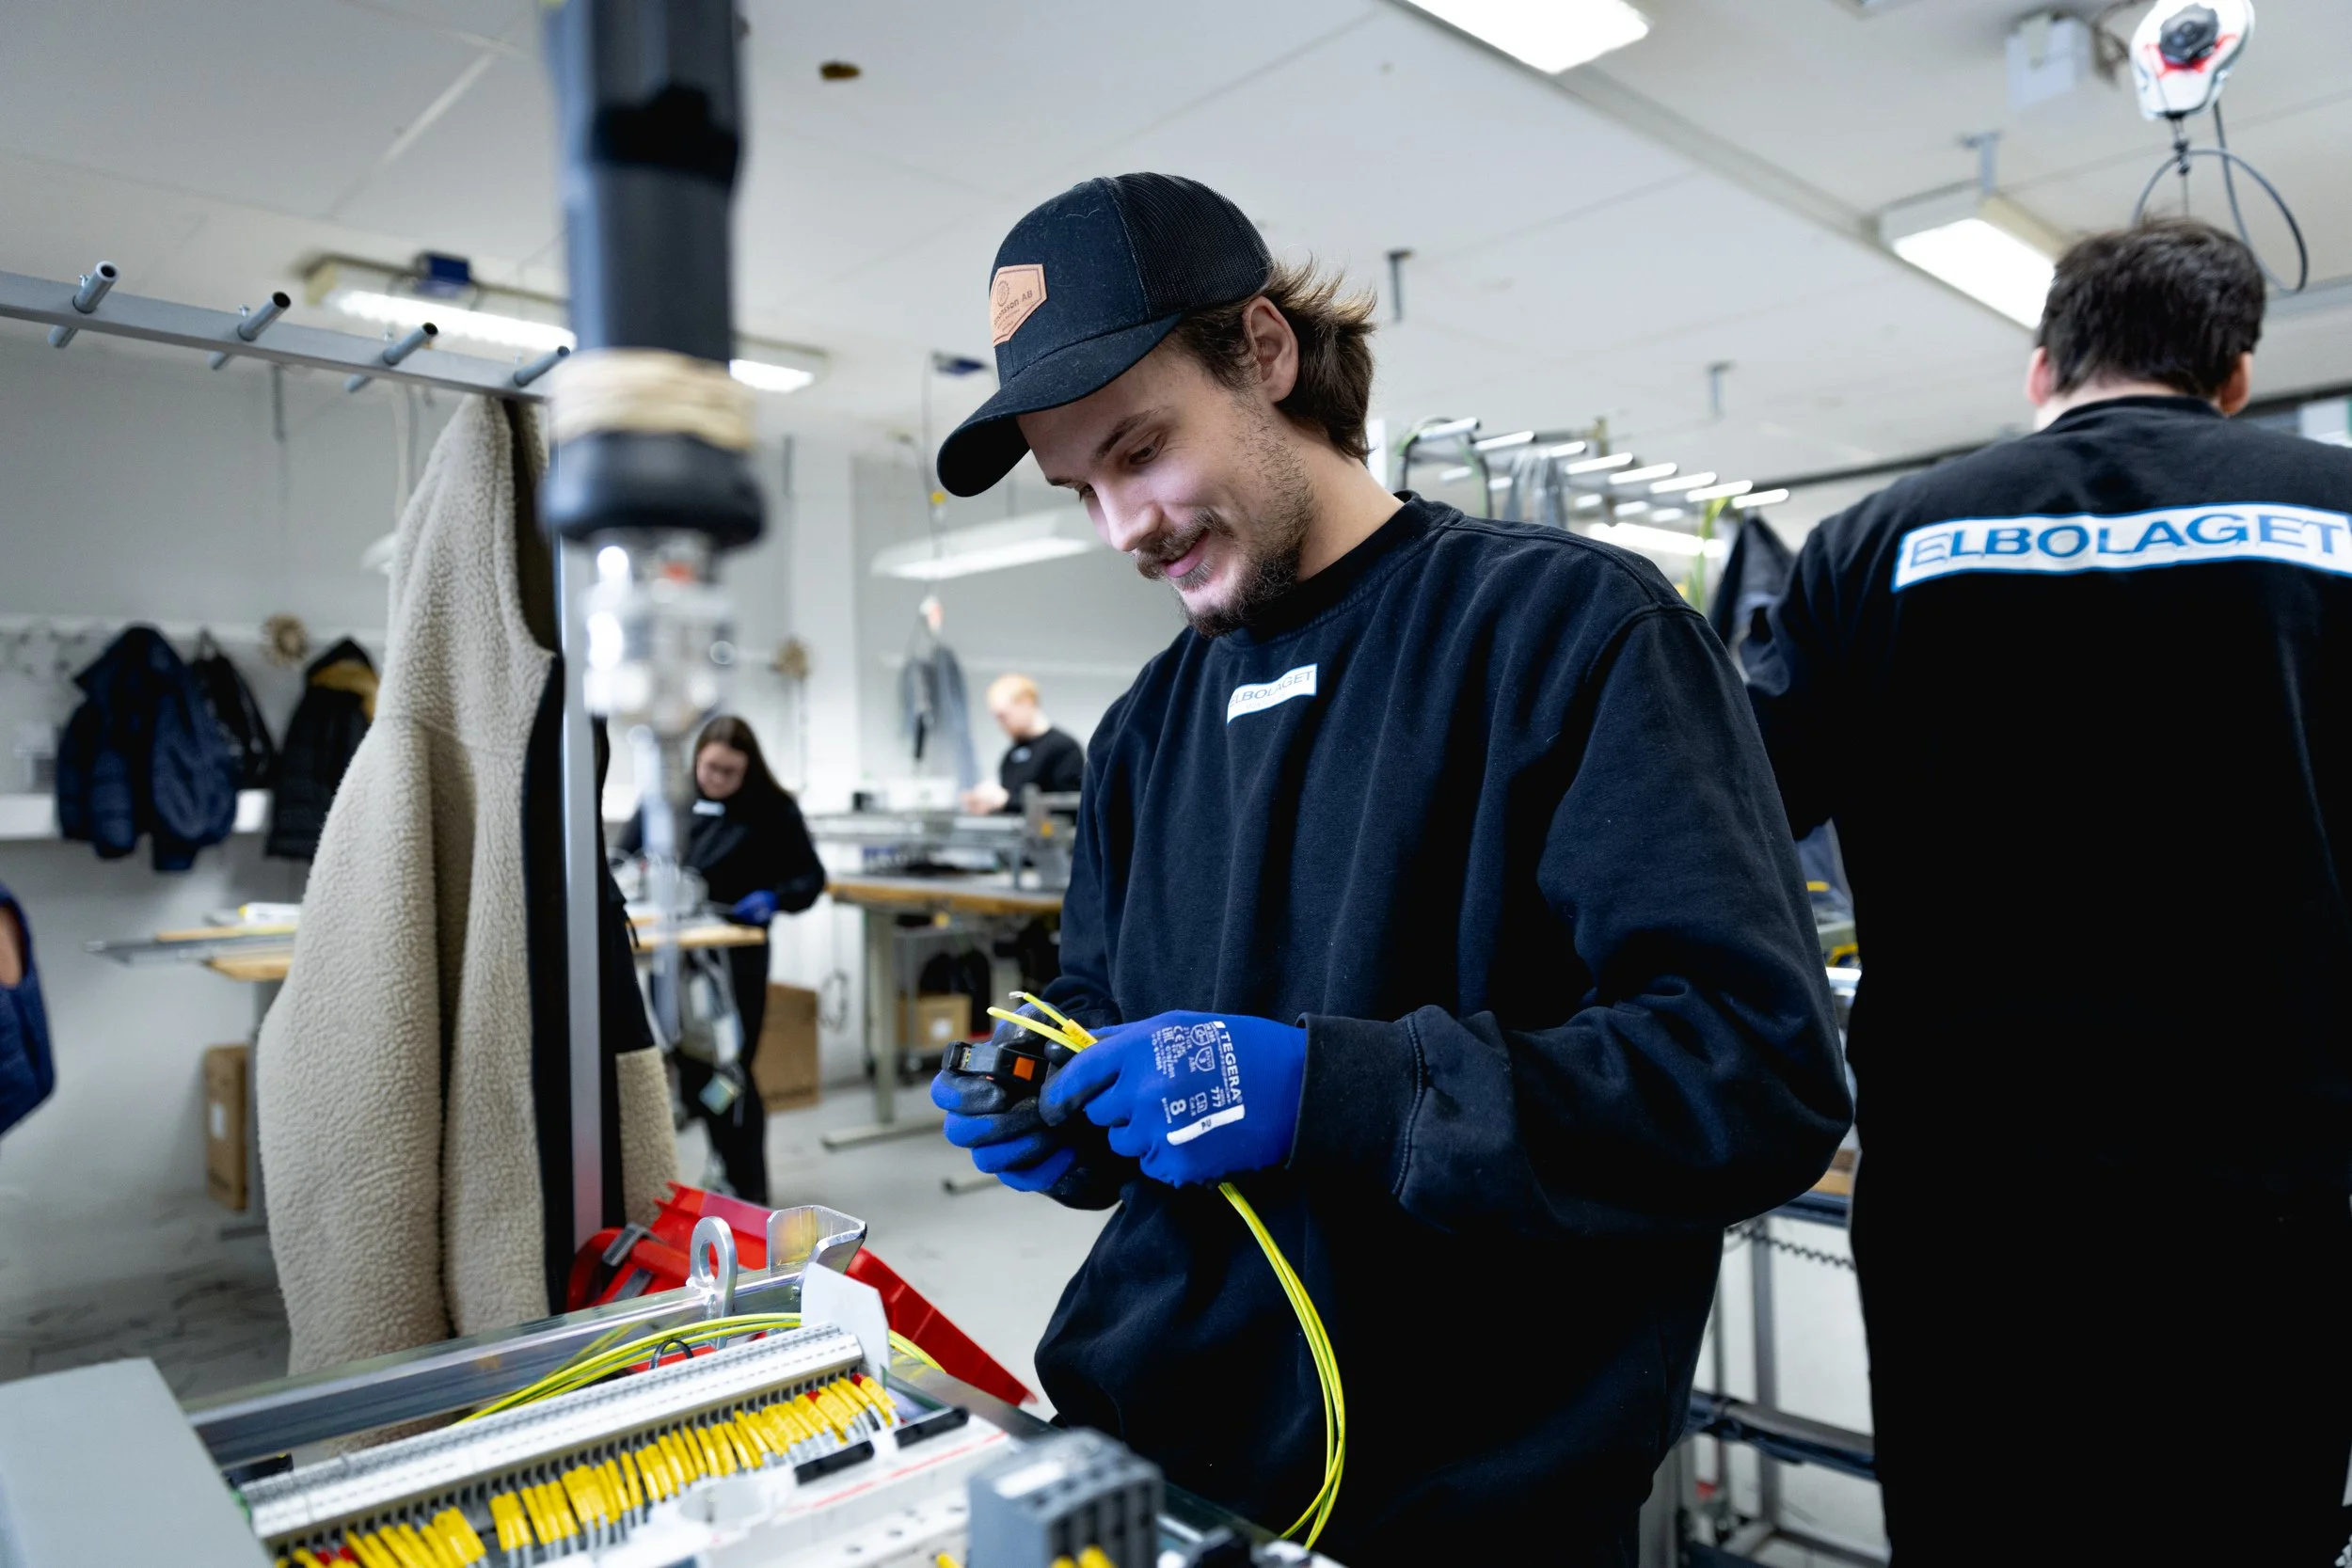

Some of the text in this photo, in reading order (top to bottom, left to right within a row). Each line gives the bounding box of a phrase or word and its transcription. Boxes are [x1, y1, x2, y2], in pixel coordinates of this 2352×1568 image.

[1022, 290, 1033, 302] AB
[1911, 513, 2344, 568] ELBOLAGET
[1211, 1085, 1221, 1108] 777
[1169, 1099, 1187, 1116] 8
[1200, 1119, 1212, 1131] PU
